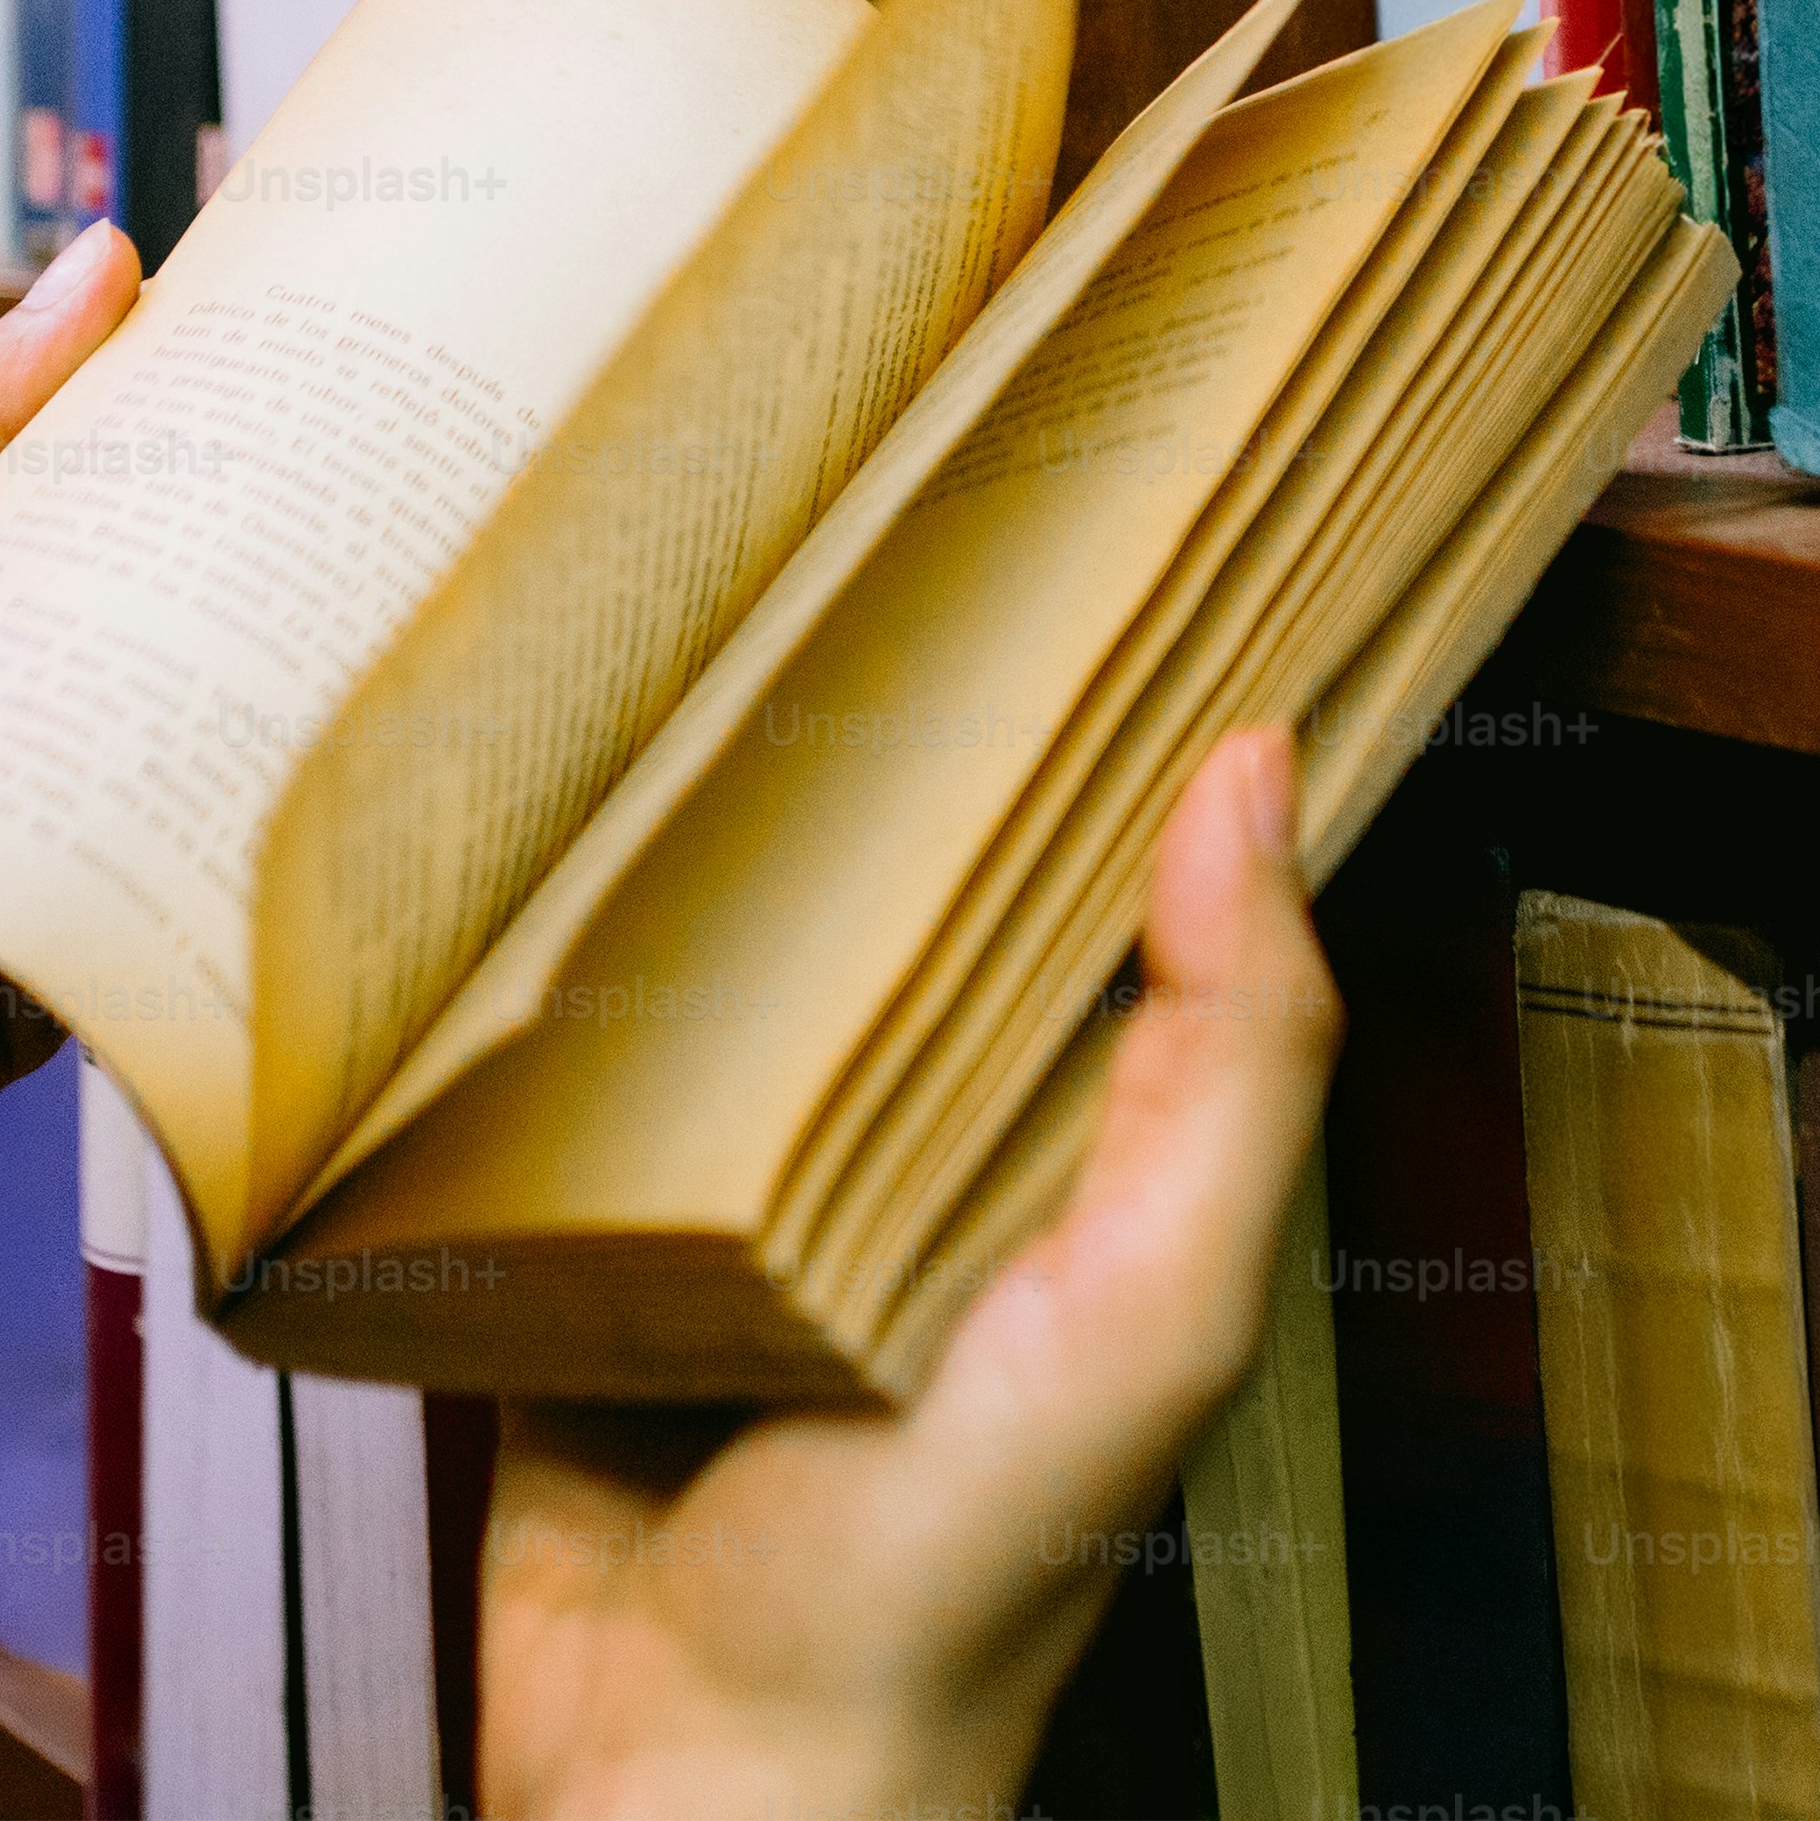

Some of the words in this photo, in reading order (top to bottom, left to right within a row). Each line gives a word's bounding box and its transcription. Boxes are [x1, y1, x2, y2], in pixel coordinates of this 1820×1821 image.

[263, 311, 289, 327] de
[221, 329, 247, 344] de
[265, 283, 336, 313] Cuatro
[350, 310, 411, 343] meses
[425, 344, 504, 402] después
